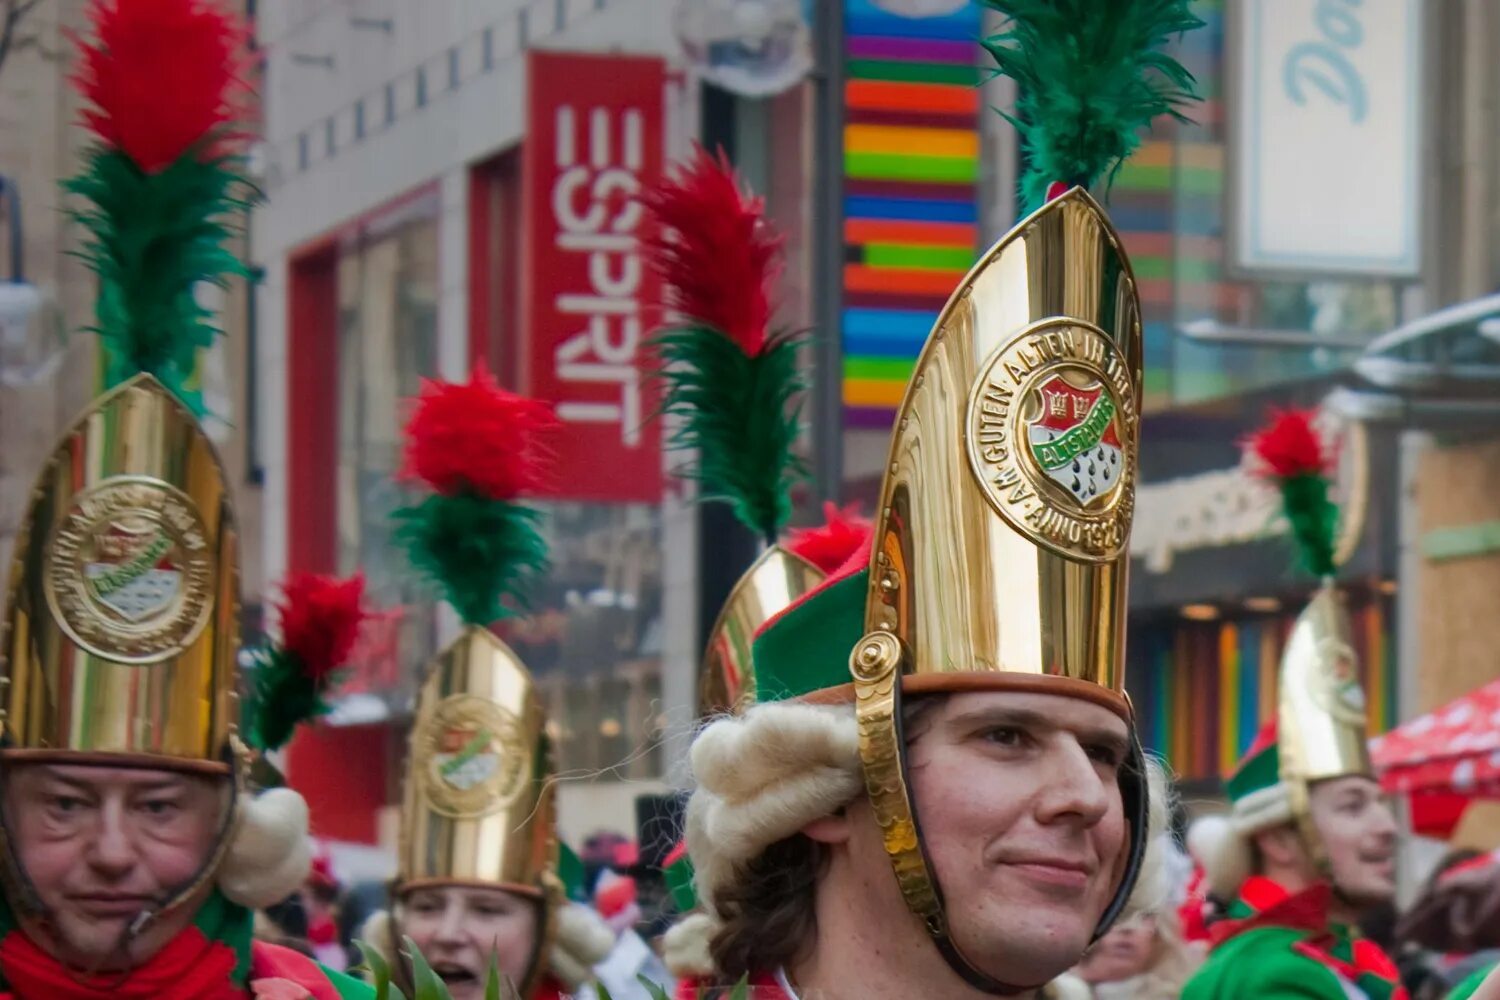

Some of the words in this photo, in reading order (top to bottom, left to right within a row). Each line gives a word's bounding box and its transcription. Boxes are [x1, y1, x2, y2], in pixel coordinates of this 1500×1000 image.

[1282, 0, 1369, 126] Do
[552, 104, 643, 448] ESPRIT
[1003, 330, 1075, 386] ALTEN
[1084, 334, 1105, 362] IN
[978, 382, 1015, 465] GUTEN
[992, 466, 1037, 505] AM
[1023, 503, 1081, 543] ANNO
